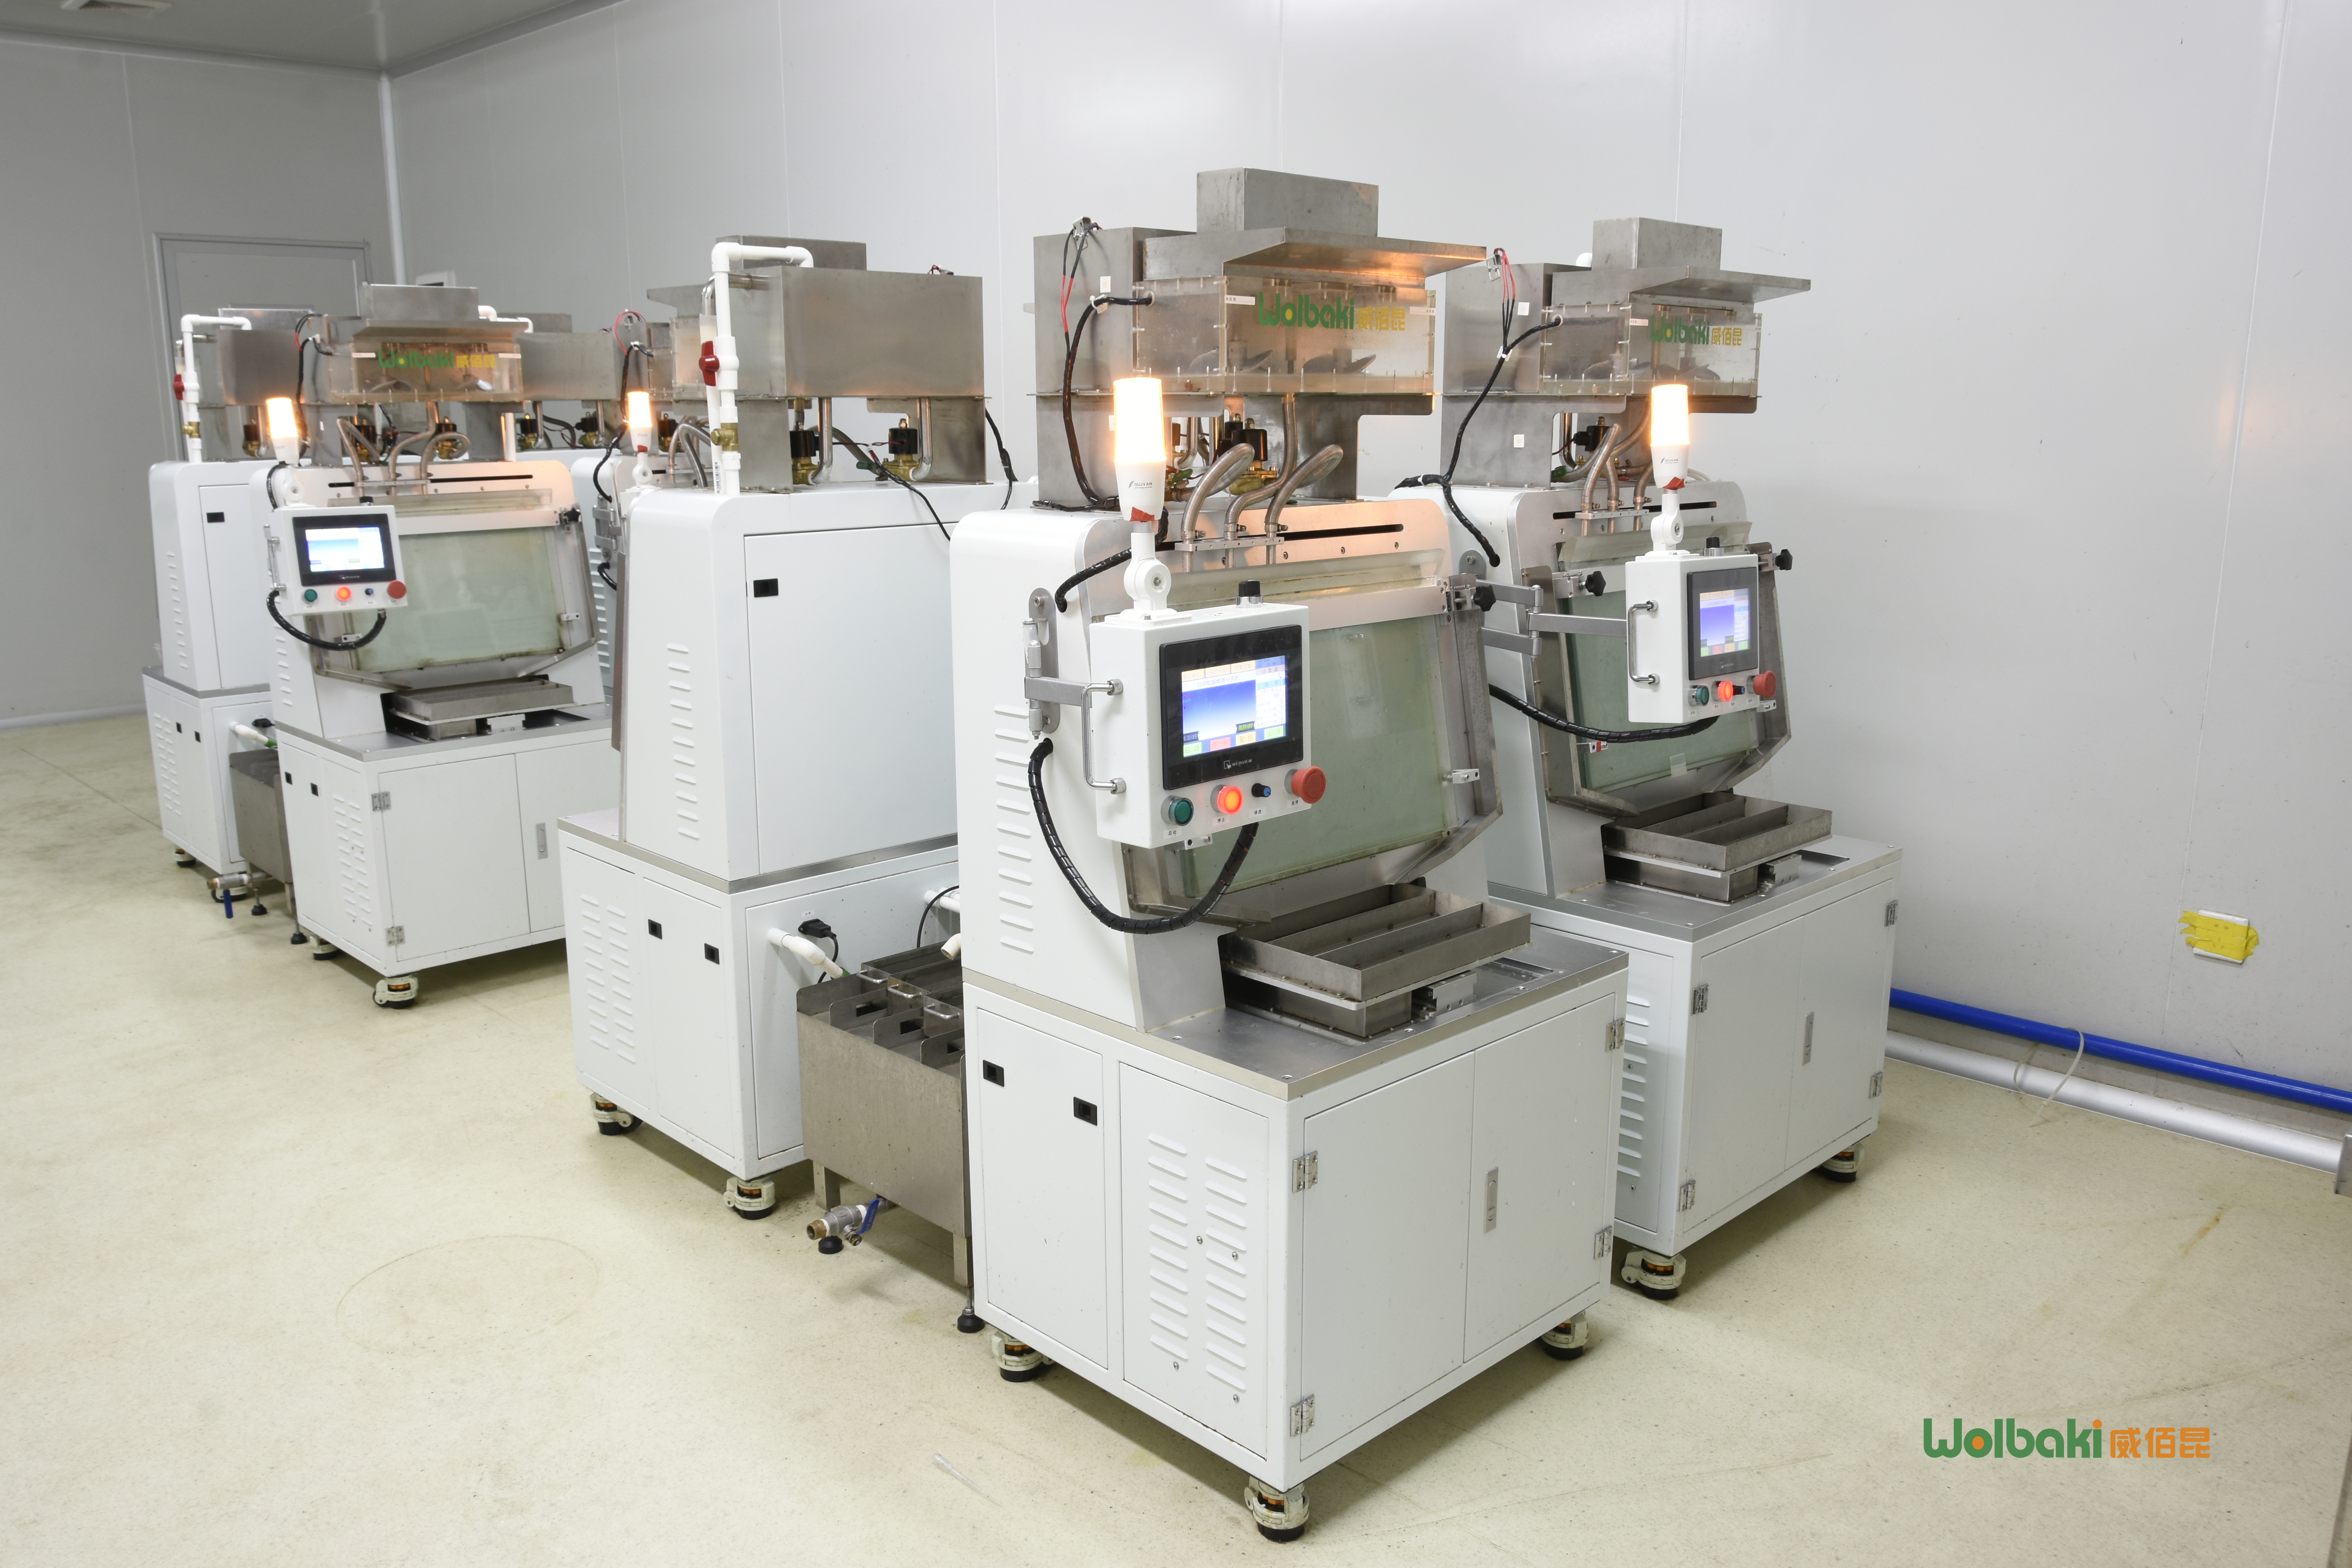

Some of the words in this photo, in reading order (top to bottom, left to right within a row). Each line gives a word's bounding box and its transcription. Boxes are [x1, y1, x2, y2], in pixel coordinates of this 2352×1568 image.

[1258, 292, 1355, 329] Wolbaki
[1358, 307, 1406, 331] 威佰昆
[1650, 315, 1710, 345] Wolbaki
[1711, 327, 1742, 346] 威佰昆
[377, 350, 455, 368] Wolbaki
[1239, 734, 1254, 743] 复位
[1185, 744, 1200, 754] 启动
